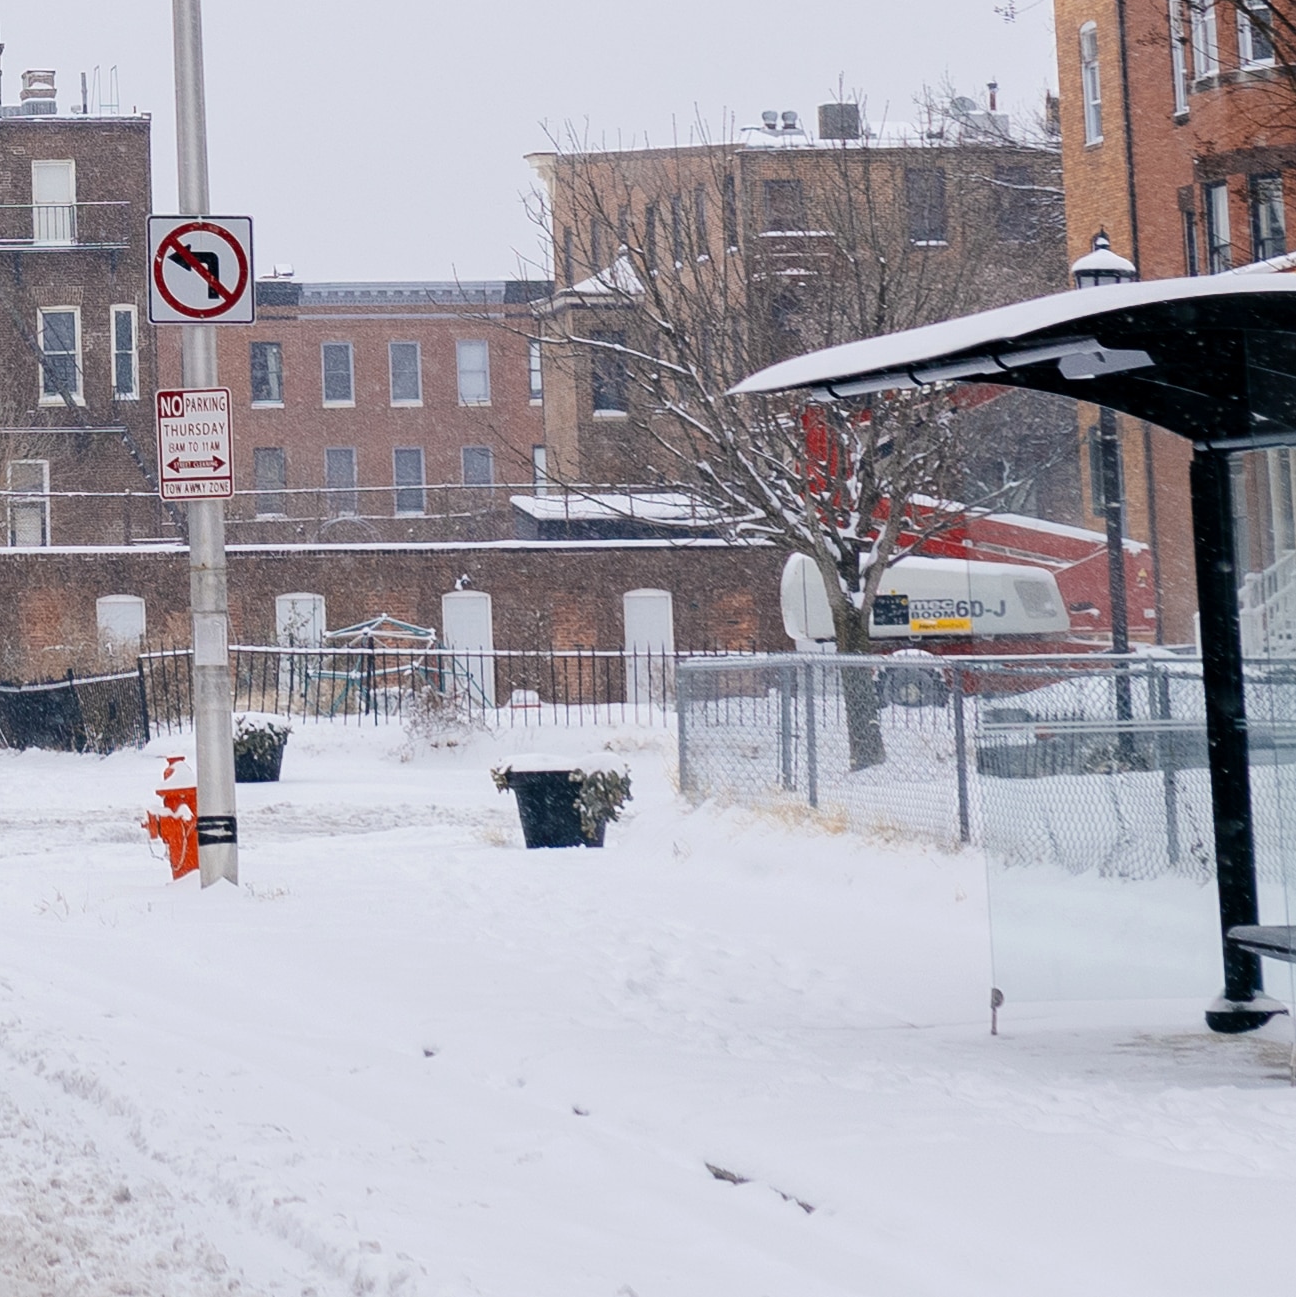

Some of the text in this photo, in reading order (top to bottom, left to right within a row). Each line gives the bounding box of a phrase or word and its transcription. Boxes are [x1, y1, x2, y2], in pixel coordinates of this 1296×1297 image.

[160, 395, 226, 416] NO PARKING
[163, 422, 225, 437] THURSDAY
[168, 442, 186, 454] 8AM
[188, 441, 199, 453] TO
[165, 481, 229, 495] TOW AWAY ZONE
[911, 610, 955, 619] BOOM
